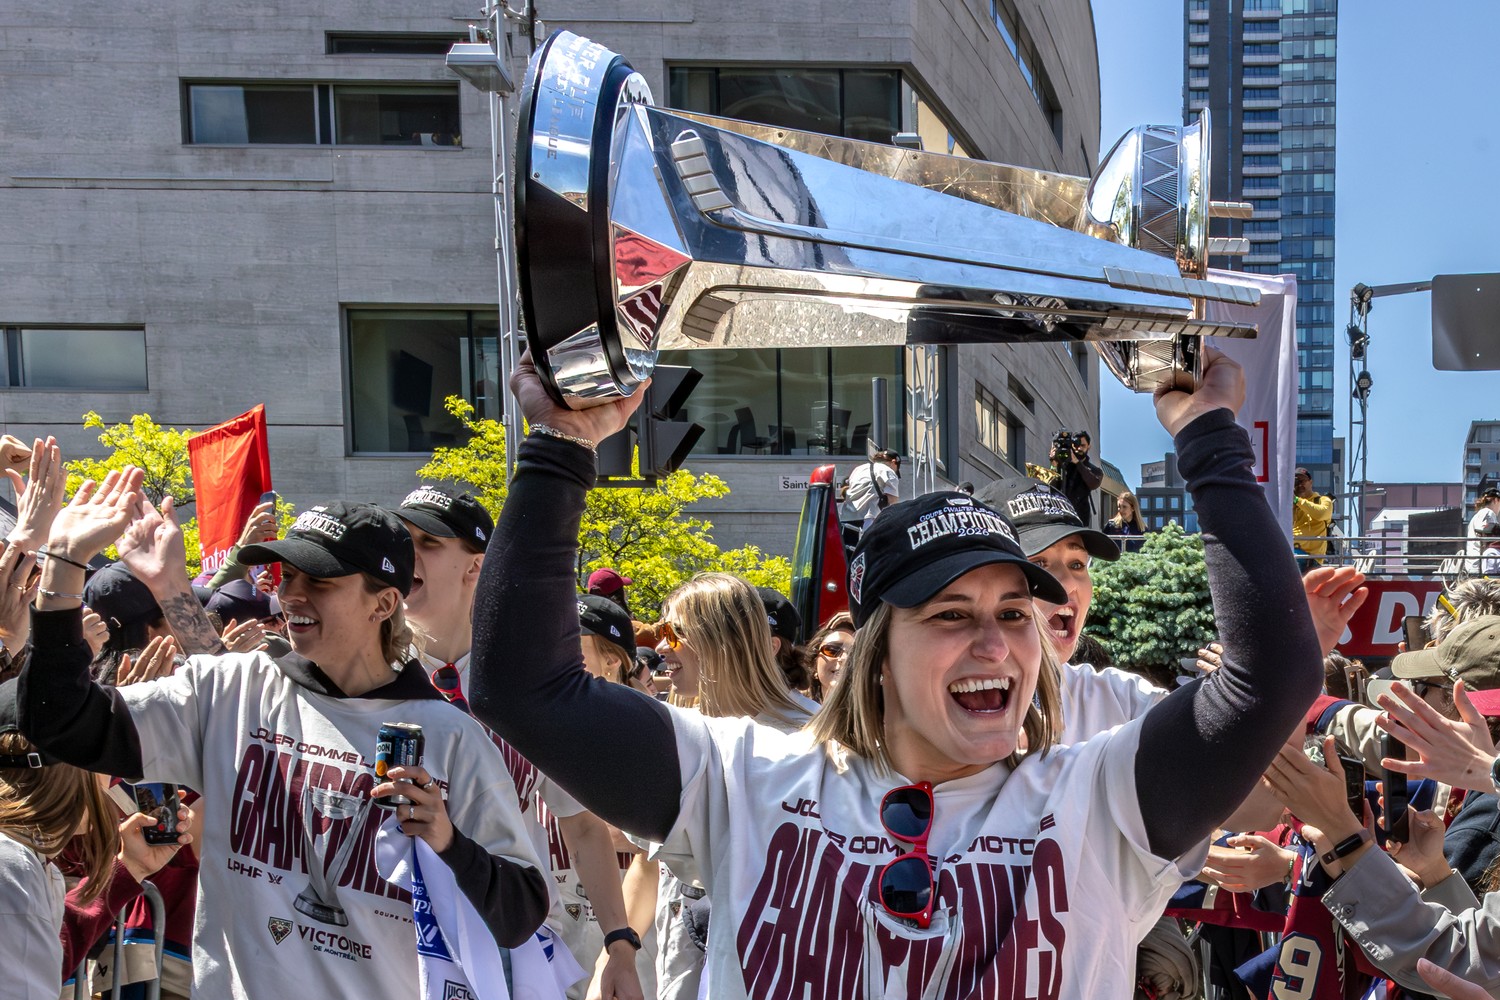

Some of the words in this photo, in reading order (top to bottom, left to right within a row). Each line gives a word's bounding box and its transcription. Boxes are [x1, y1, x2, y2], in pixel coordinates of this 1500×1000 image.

[782, 480, 808, 489] Saint
[958, 527, 989, 538] 2026
[250, 728, 294, 749] JOUER
[296, 742, 358, 765] COMME
[227, 858, 263, 879] LPHF
[297, 925, 372, 960] VICTOIRE
[313, 944, 322, 952] DE
[324, 948, 358, 961] MONTRÉAL
